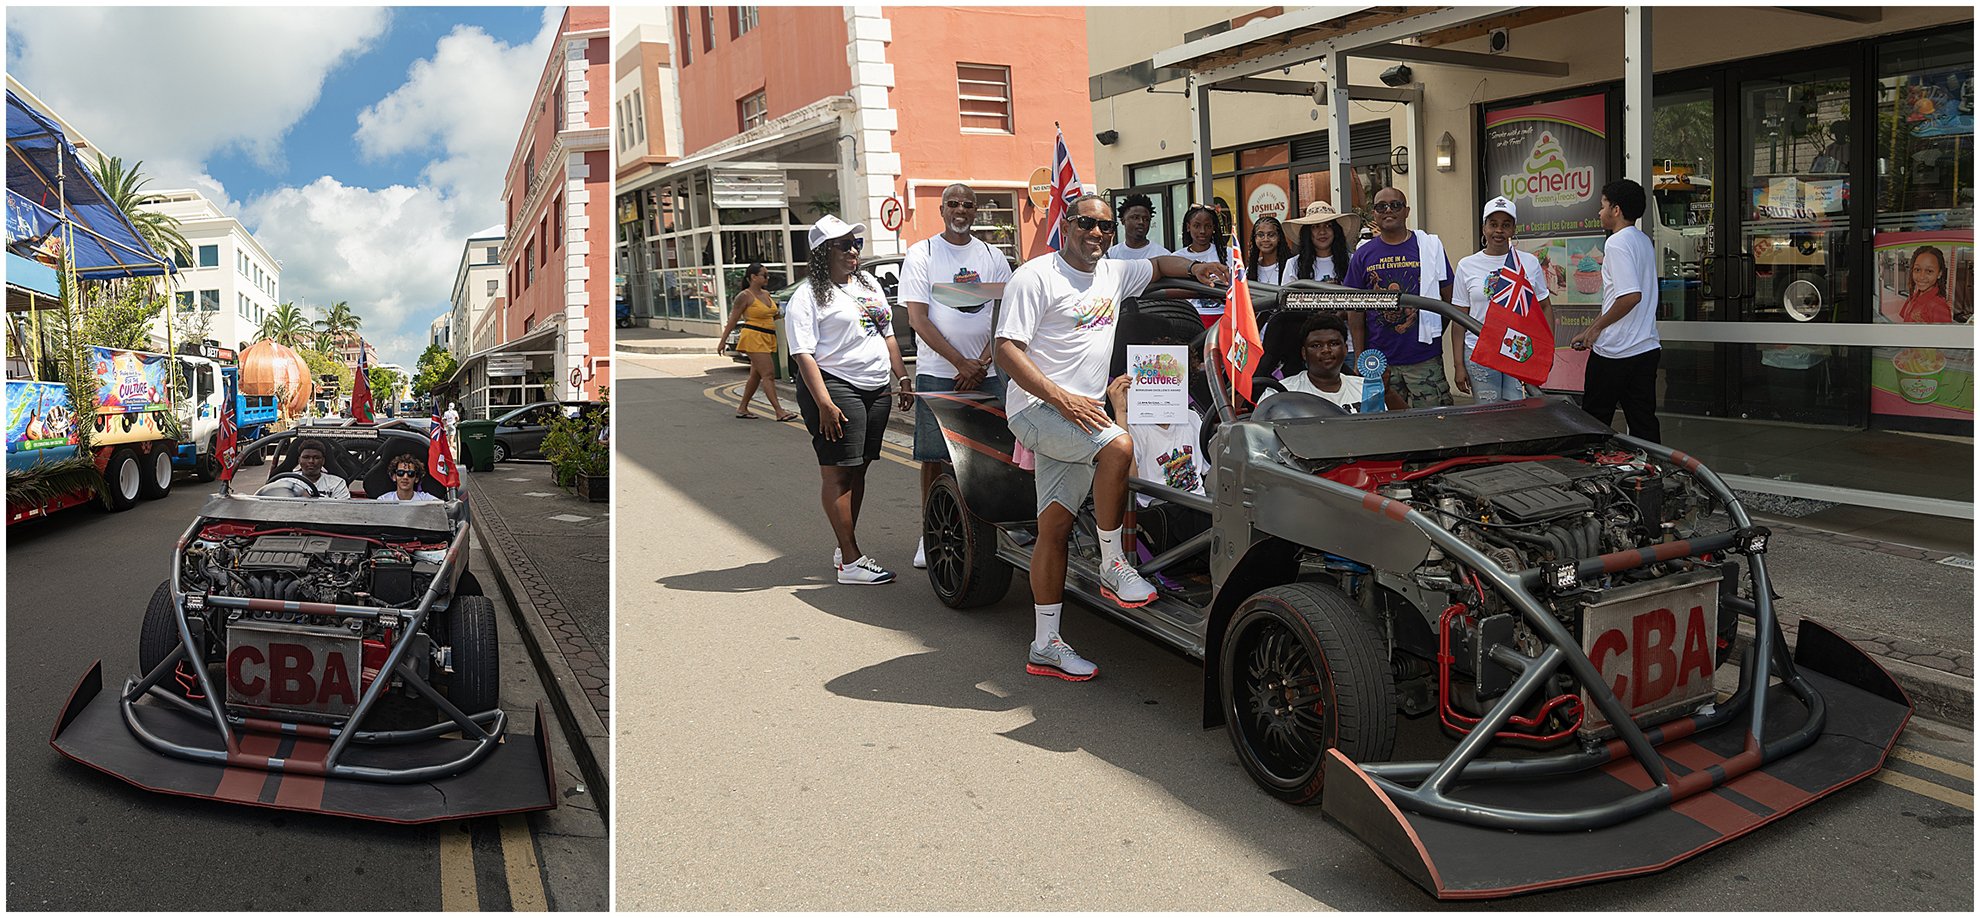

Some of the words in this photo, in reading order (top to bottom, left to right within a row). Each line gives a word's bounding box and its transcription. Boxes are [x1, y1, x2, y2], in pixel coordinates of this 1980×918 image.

[1503, 170, 1591, 202] yocherry
[1535, 194, 1555, 203] Frozen
[1556, 192, 1576, 201] Treats
[1251, 201, 1286, 214] JOSHUA'S
[1530, 220, 1551, 231] Custard
[1552, 220, 1560, 230] Ice
[1561, 220, 1578, 229] Cream
[1366, 263, 1386, 272] HOSTILE
[1561, 315, 1580, 326] Cheese
[207, 346, 219, 358] BEST
[1140, 369, 1158, 377] FOR
[1140, 376, 1178, 385] CULTURE
[119, 382, 148, 398] CULTURE
[1588, 605, 1713, 709] CBA
[227, 643, 357, 705] CBA
